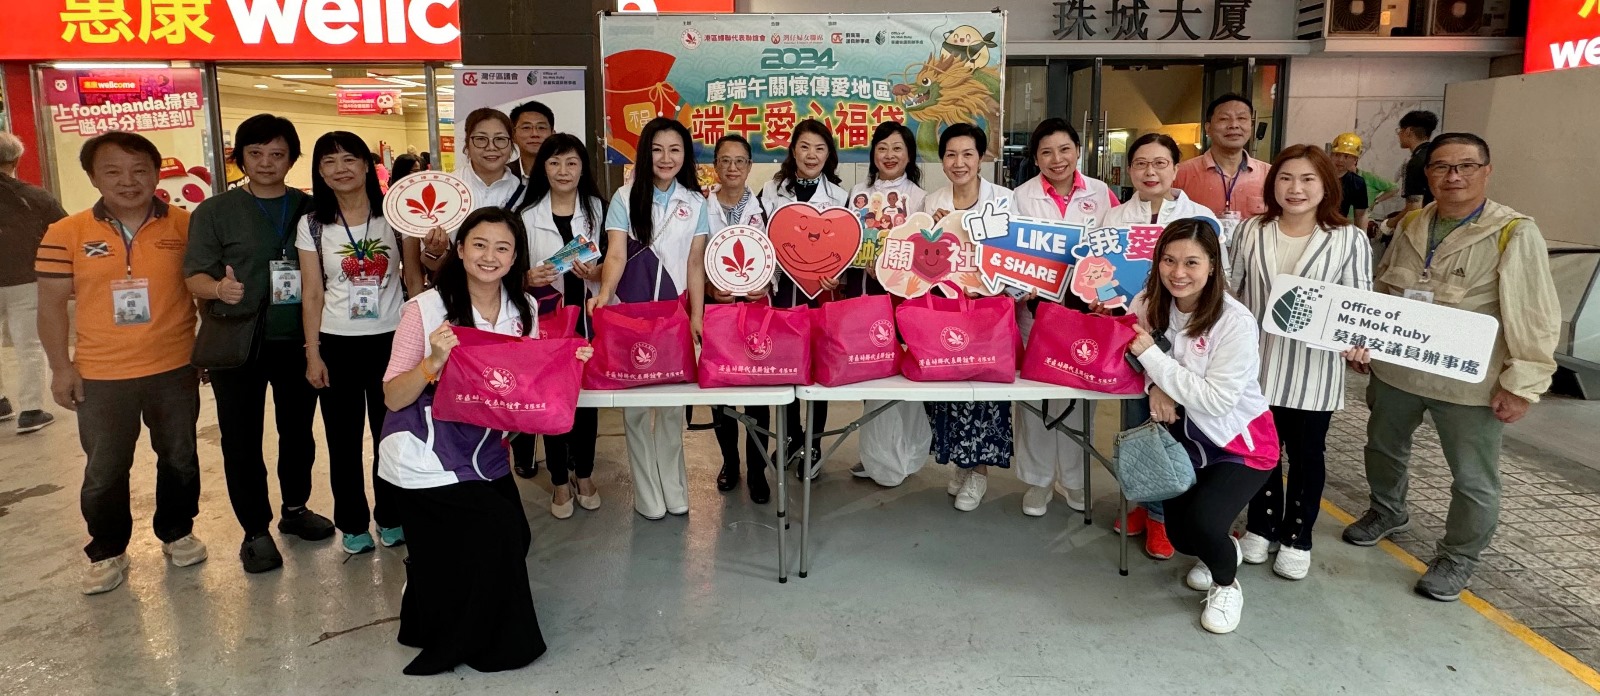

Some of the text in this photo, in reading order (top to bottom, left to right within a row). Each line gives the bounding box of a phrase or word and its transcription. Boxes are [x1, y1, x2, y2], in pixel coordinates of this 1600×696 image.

[60, 0, 215, 44] 惠康
[1052, 0, 1252, 41] 珠城大廈
[761, 47, 838, 70] 2024
[98, 81, 136, 89] wellcome
[706, 75, 893, 102] 慶端午關懷傳愛地區
[56, 92, 200, 120] 上foodpanda掃貨
[1016, 228, 1067, 254] LIKE
[989, 254, 1058, 284] & SHARE
[1340, 300, 1402, 321] Office of
[1337, 313, 1431, 344] Ms Mok Ruby
